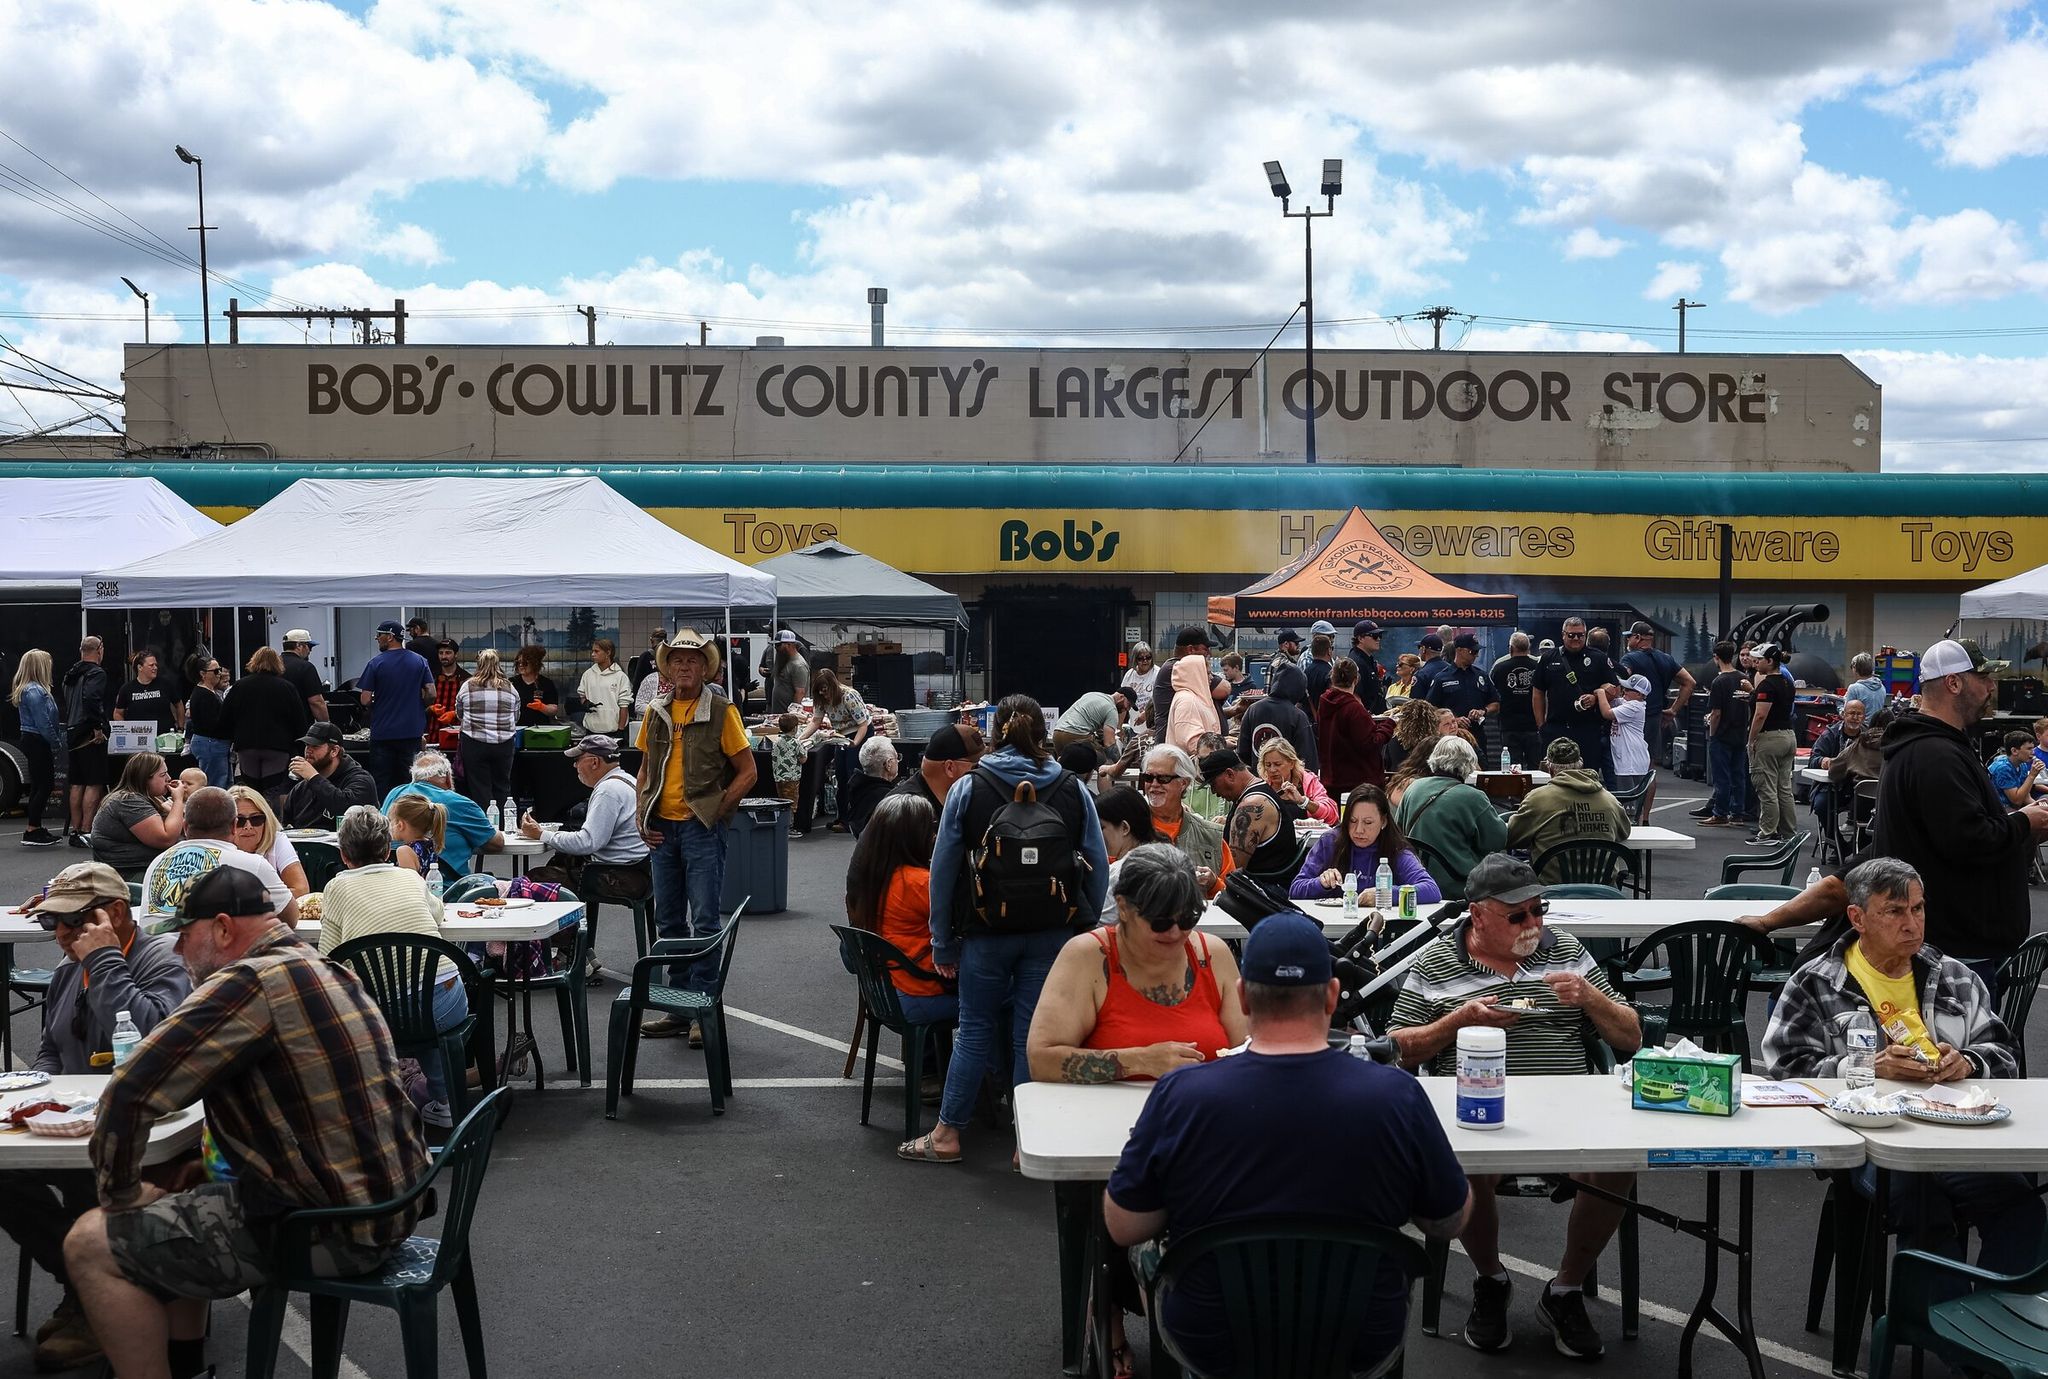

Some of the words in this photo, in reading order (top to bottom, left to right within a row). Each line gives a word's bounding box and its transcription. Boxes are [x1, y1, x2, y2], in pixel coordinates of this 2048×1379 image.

[307, 355, 455, 416] BOB'S
[486, 362, 725, 417] COWLITZ
[756, 358, 999, 419] COUNTY'S
[1029, 366, 1253, 419] LARGEST
[1282, 368, 1571, 423] OUTDOOR
[1603, 372, 1767, 423] STORE
[1000, 519, 1120, 562] Bob's
[1280, 515, 1575, 558] Hsewares
[1901, 522, 2014, 571] Toys
[1324, 543, 1359, 567] SMOKIN
[96, 581, 119, 590] QUIK
[96, 589, 119, 597] SHADE
[1248, 608, 1429, 620] www.smokinfranksbbqco.com
[1432, 608, 1505, 619] 360-991-8215
[1576, 802, 1590, 811] NO
[1577, 812, 1605, 822] RIVER
[1579, 823, 1610, 833] NAMES
